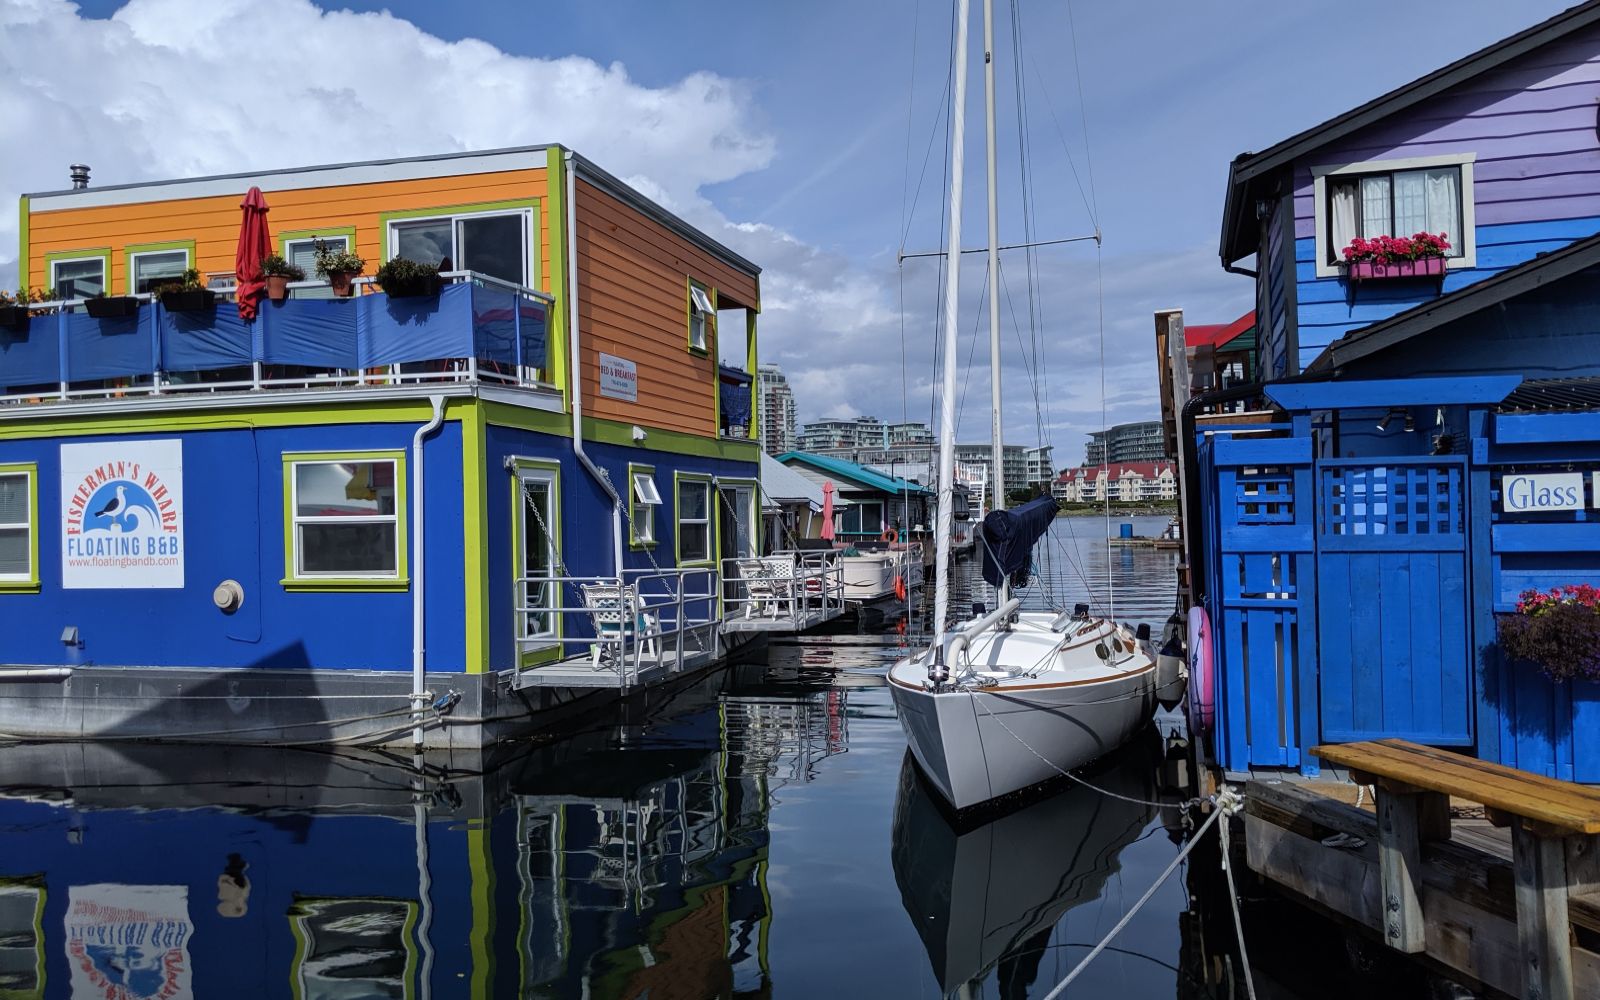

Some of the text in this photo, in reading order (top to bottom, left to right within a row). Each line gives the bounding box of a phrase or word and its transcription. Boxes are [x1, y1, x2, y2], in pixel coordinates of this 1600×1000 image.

[67, 461, 178, 535] FISHERMAN'S WHARF
[1508, 477, 1577, 510] Glass
[68, 536, 178, 556] FLOATING B&B
[69, 556, 179, 569] www.floatingbandb.com
